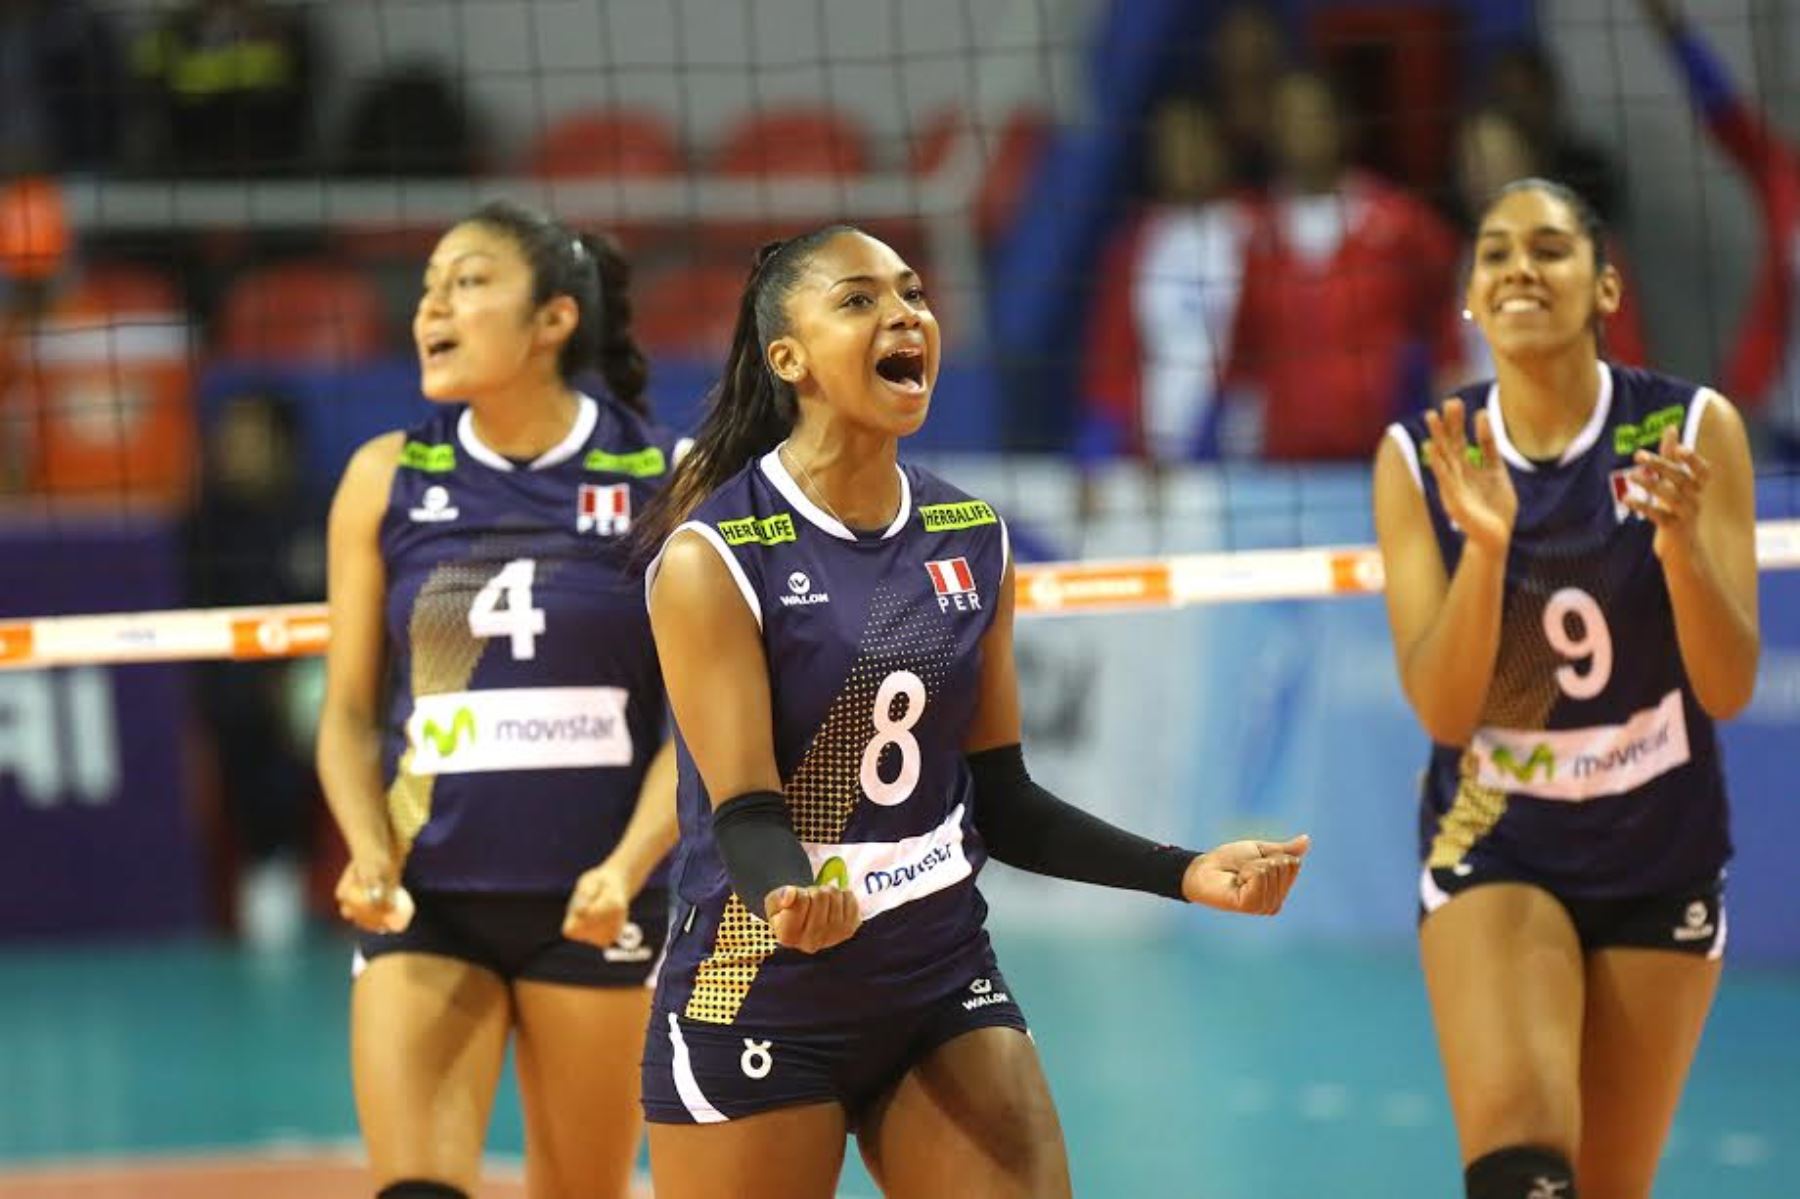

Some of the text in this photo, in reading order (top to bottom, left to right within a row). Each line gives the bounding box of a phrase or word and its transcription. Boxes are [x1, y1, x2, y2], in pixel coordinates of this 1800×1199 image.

[924, 504, 992, 526] HERBALIFE
[468, 558, 546, 660] 4
[938, 592, 982, 613] PER
[1542, 587, 1613, 700] 9
[495, 713, 617, 742] movistar
[860, 670, 926, 806] 8
